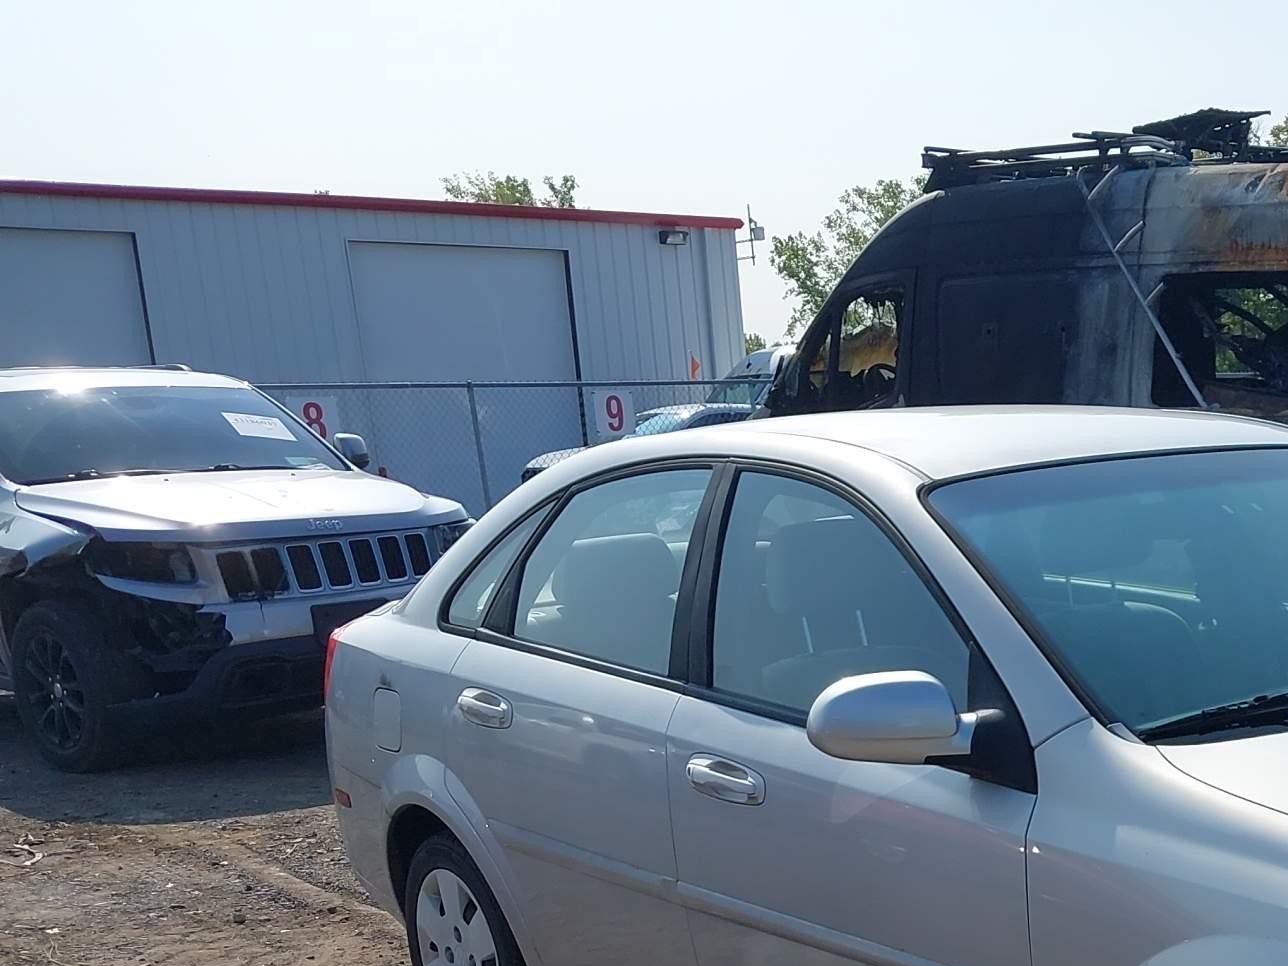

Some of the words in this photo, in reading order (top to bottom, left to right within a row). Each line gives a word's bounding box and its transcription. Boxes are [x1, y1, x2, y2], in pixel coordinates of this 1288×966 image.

[303, 402, 327, 440] 8
[606, 395, 624, 432] 9
[304, 518, 343, 530] Jeep
